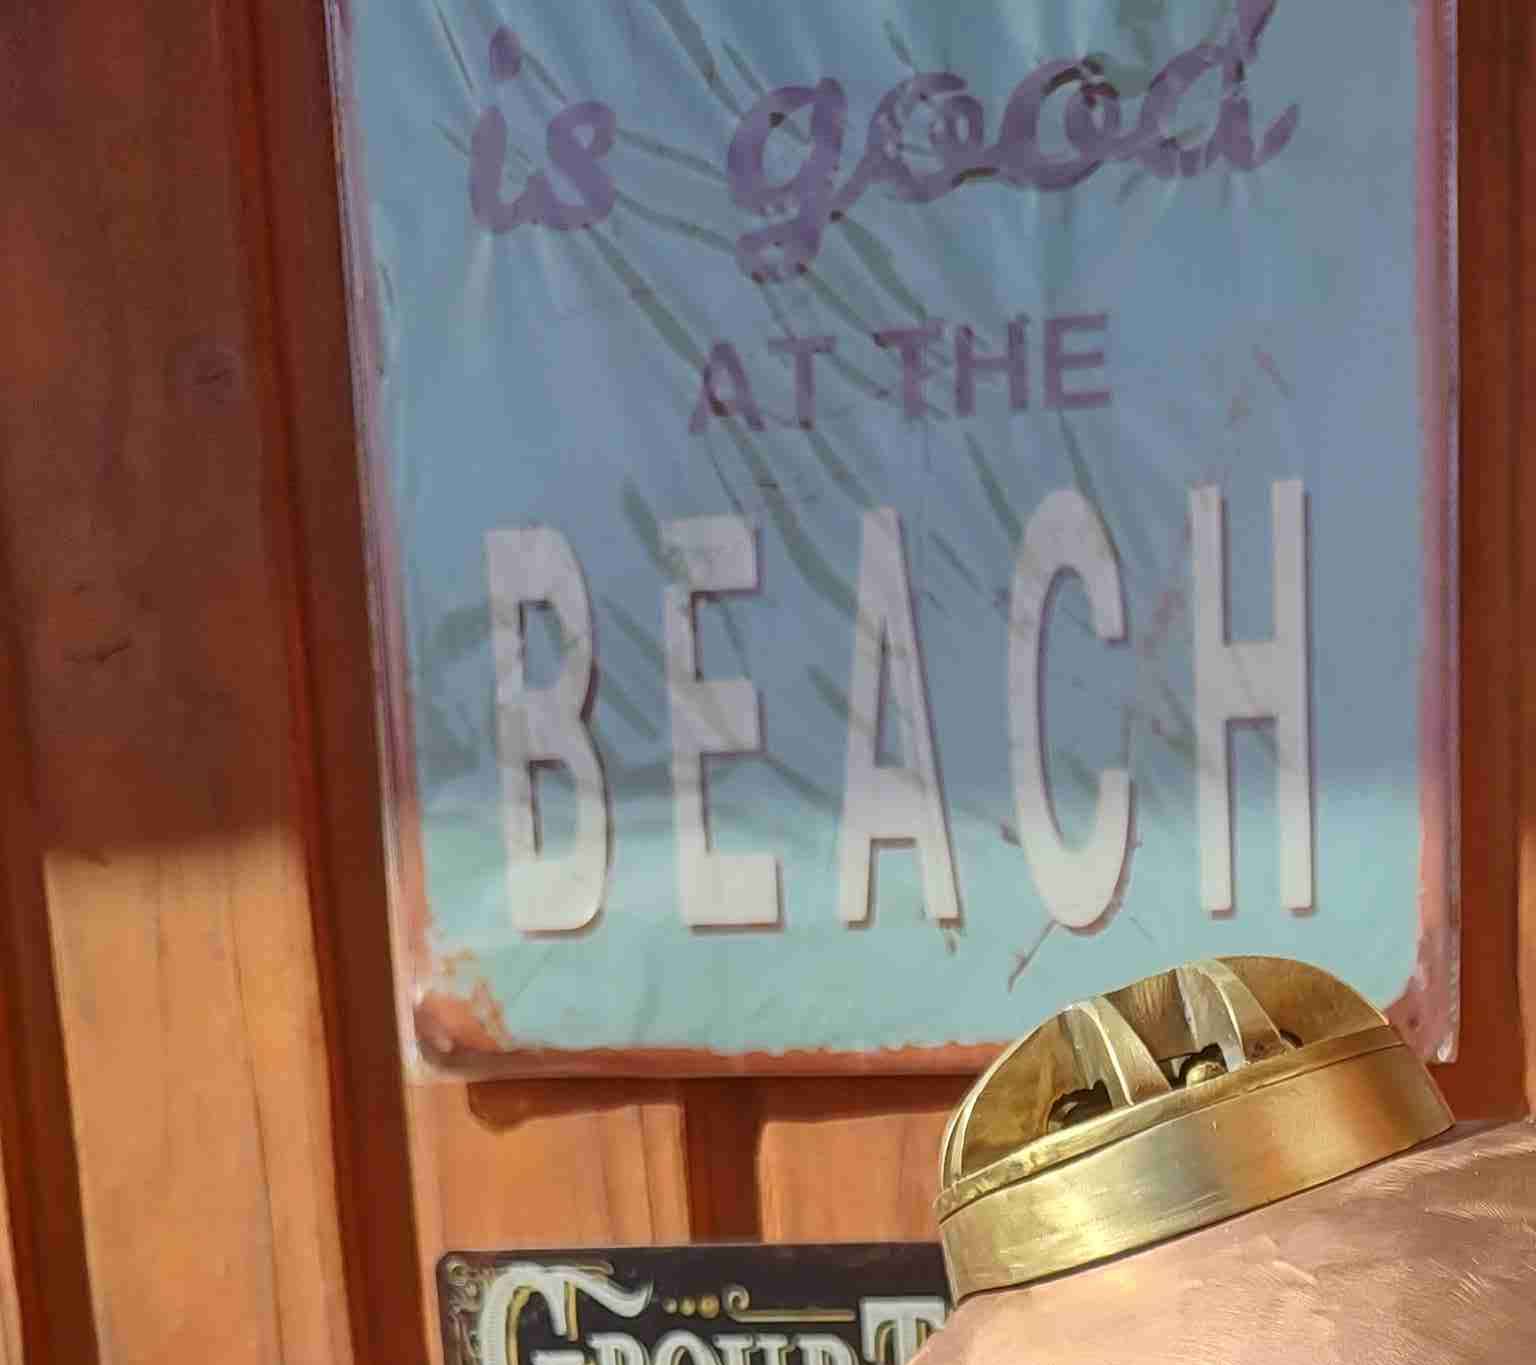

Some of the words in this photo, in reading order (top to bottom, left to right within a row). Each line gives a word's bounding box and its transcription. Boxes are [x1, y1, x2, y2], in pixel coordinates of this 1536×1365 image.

[468, 25, 617, 234] is
[726, 0, 1300, 284] good
[688, 336, 836, 434] AT
[874, 312, 1112, 418] THE
[484, 478, 1318, 935] BEACH
